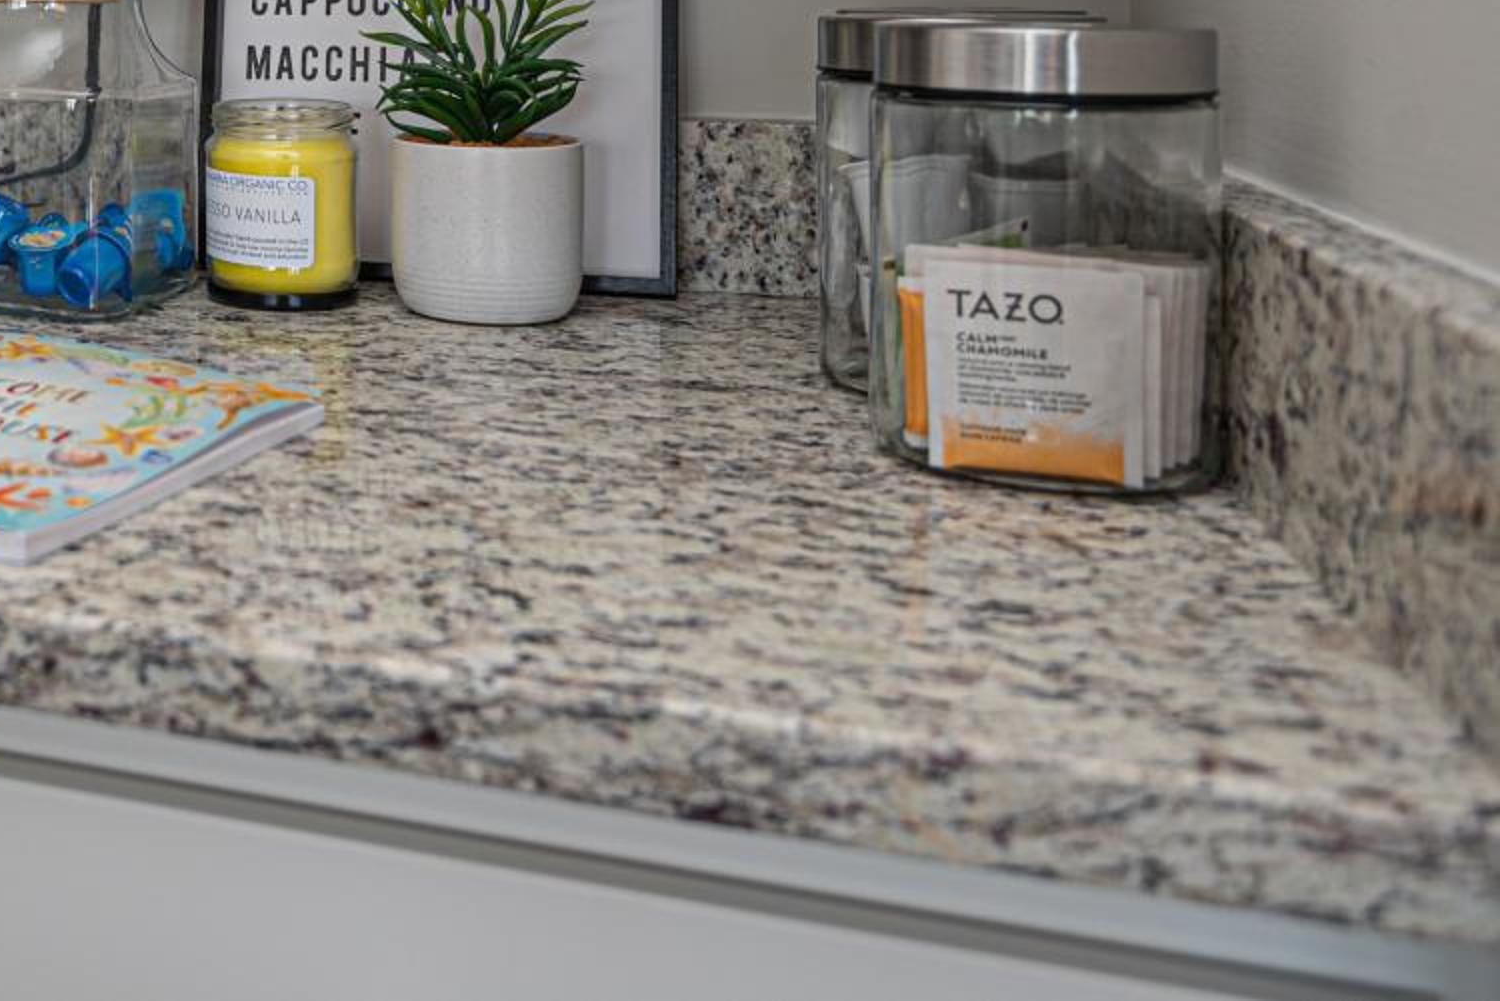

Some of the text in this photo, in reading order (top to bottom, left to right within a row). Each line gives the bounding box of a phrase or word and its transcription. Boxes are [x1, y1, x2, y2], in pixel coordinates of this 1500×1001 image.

[235, 206, 301, 225] VANILLA
[947, 289, 1064, 325] TAZO
[956, 344, 1048, 360] CHAMOMILE
